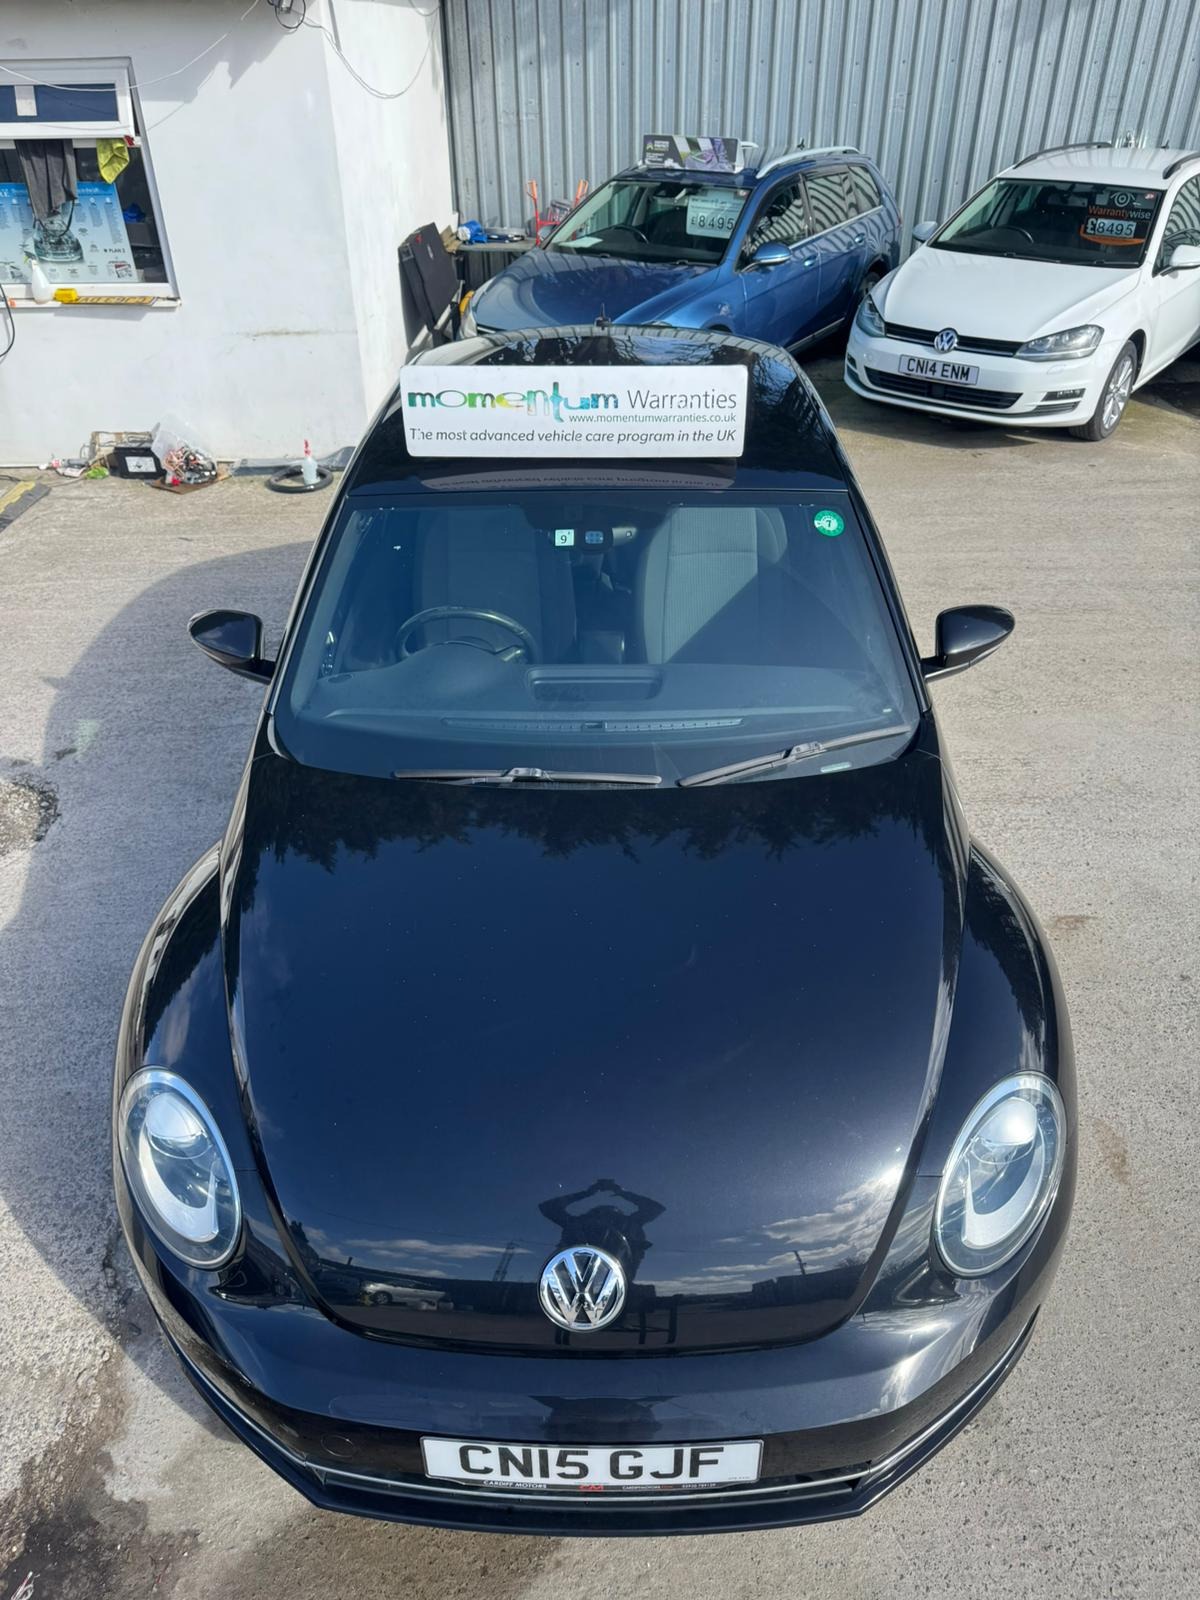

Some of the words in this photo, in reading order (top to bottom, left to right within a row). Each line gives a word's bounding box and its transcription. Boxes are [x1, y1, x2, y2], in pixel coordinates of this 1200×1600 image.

[1088, 204, 1152, 220] Warrantywise
[1085, 217, 1135, 237] £8495
[906, 357, 937, 377] CN14
[940, 363, 971, 382] ENM
[407, 381, 619, 423] momentum
[626, 388, 737, 410] Warranties
[568, 412, 736, 423] www.momentumwarranties.co.uk
[435, 430, 467, 441] most
[469, 429, 535, 442] advanced
[537, 429, 583, 442] vehicle
[585, 433, 615, 442] care
[617, 432, 675, 445] program
[677, 429, 690, 442] in
[692, 429, 714, 442] the
[716, 429, 737, 441] UK
[458, 1444, 589, 1480] CN15
[609, 1446, 725, 1479] GJF
